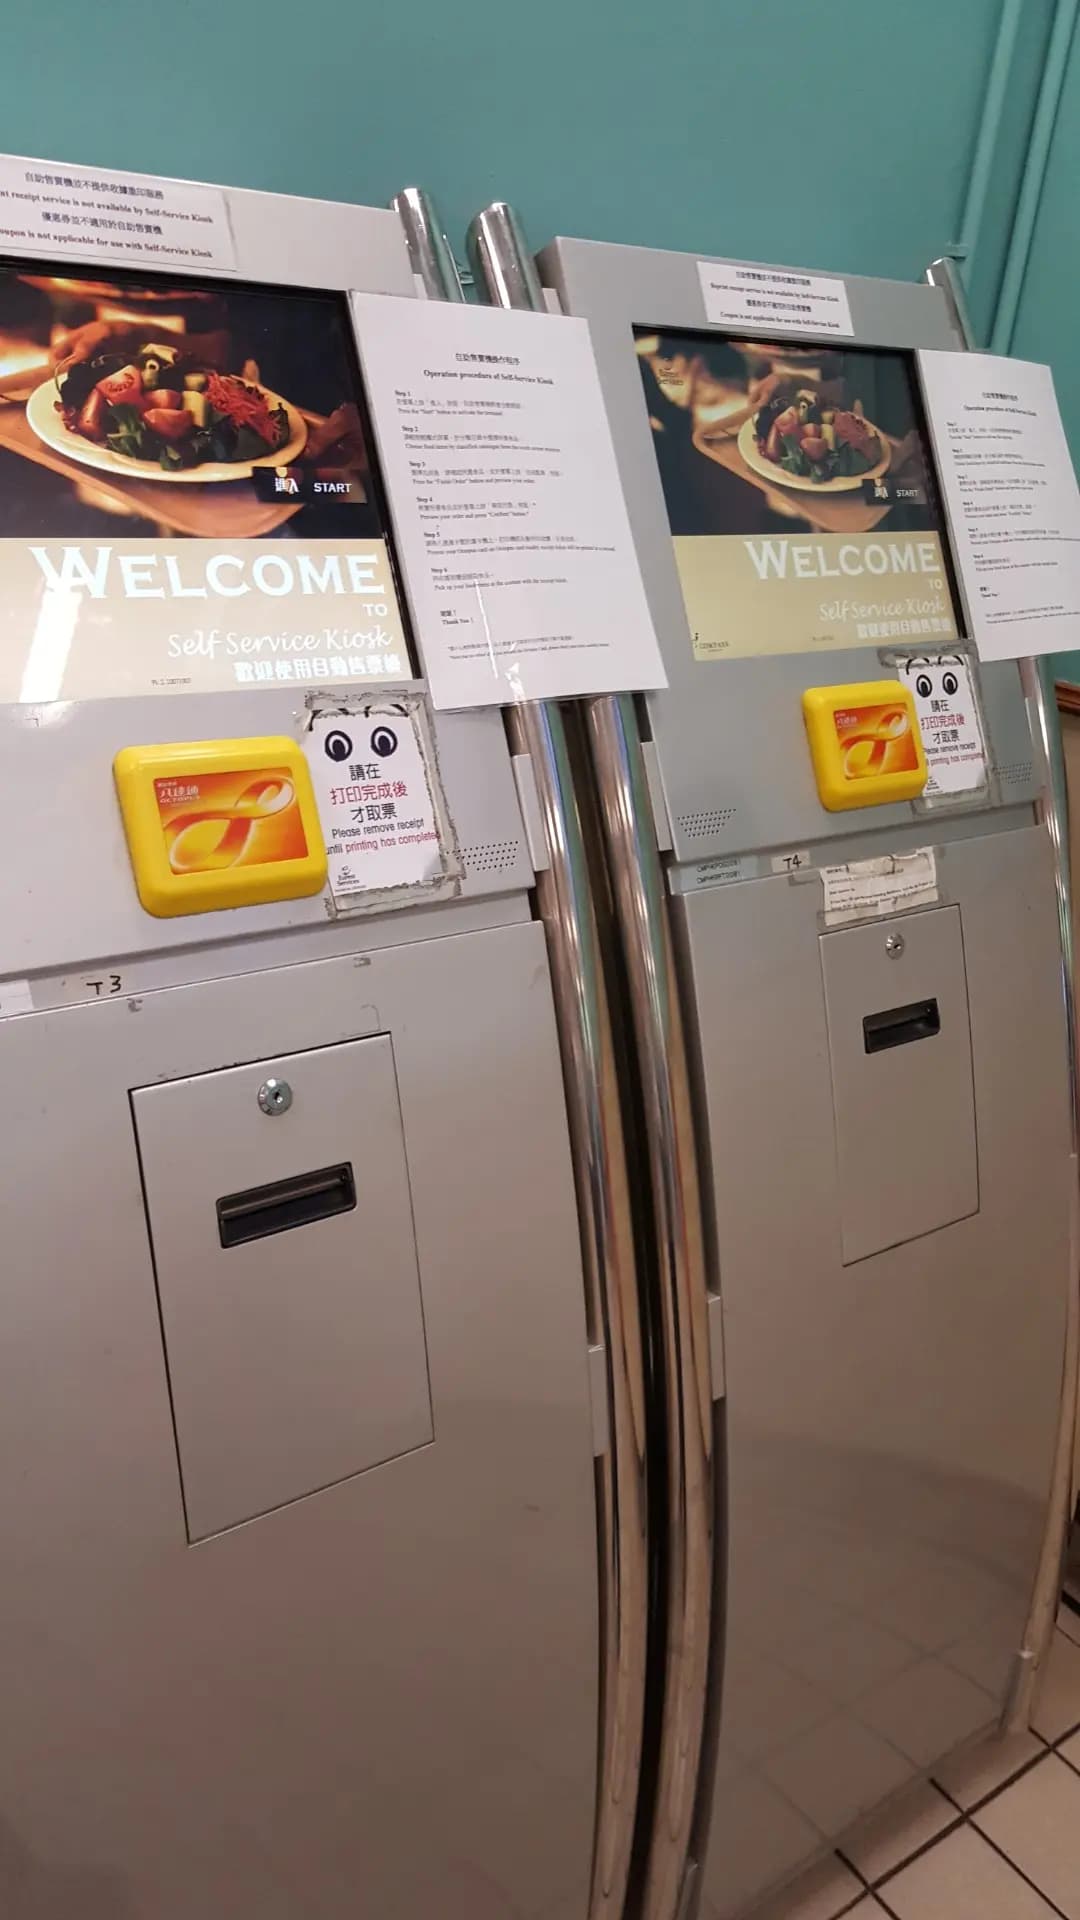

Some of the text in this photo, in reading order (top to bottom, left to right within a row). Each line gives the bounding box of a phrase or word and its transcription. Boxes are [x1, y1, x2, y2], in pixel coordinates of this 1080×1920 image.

[42, 196, 70, 205] service
[313, 482, 352, 493] START
[896, 489, 919, 497] START
[744, 540, 941, 580] WELCOME
[28, 546, 385, 599] WELCOME
[929, 578, 943, 590] TO
[363, 603, 388, 617] TO
[819, 595, 946, 623] Self Service Kiosk
[168, 624, 393, 660] Self Service Kiosk
[931, 700, 950, 712] 請在
[921, 713, 965, 730] 打印完成後
[932, 729, 960, 744] 才取票
[348, 763, 381, 781] 請在
[330, 781, 408, 805] 打印完成後
[350, 802, 398, 824] 才取票
[332, 818, 424, 839] Please remove receipt
[345, 840, 378, 854] printing
[380, 837, 397, 847] has
[783, 855, 802, 870] T4
